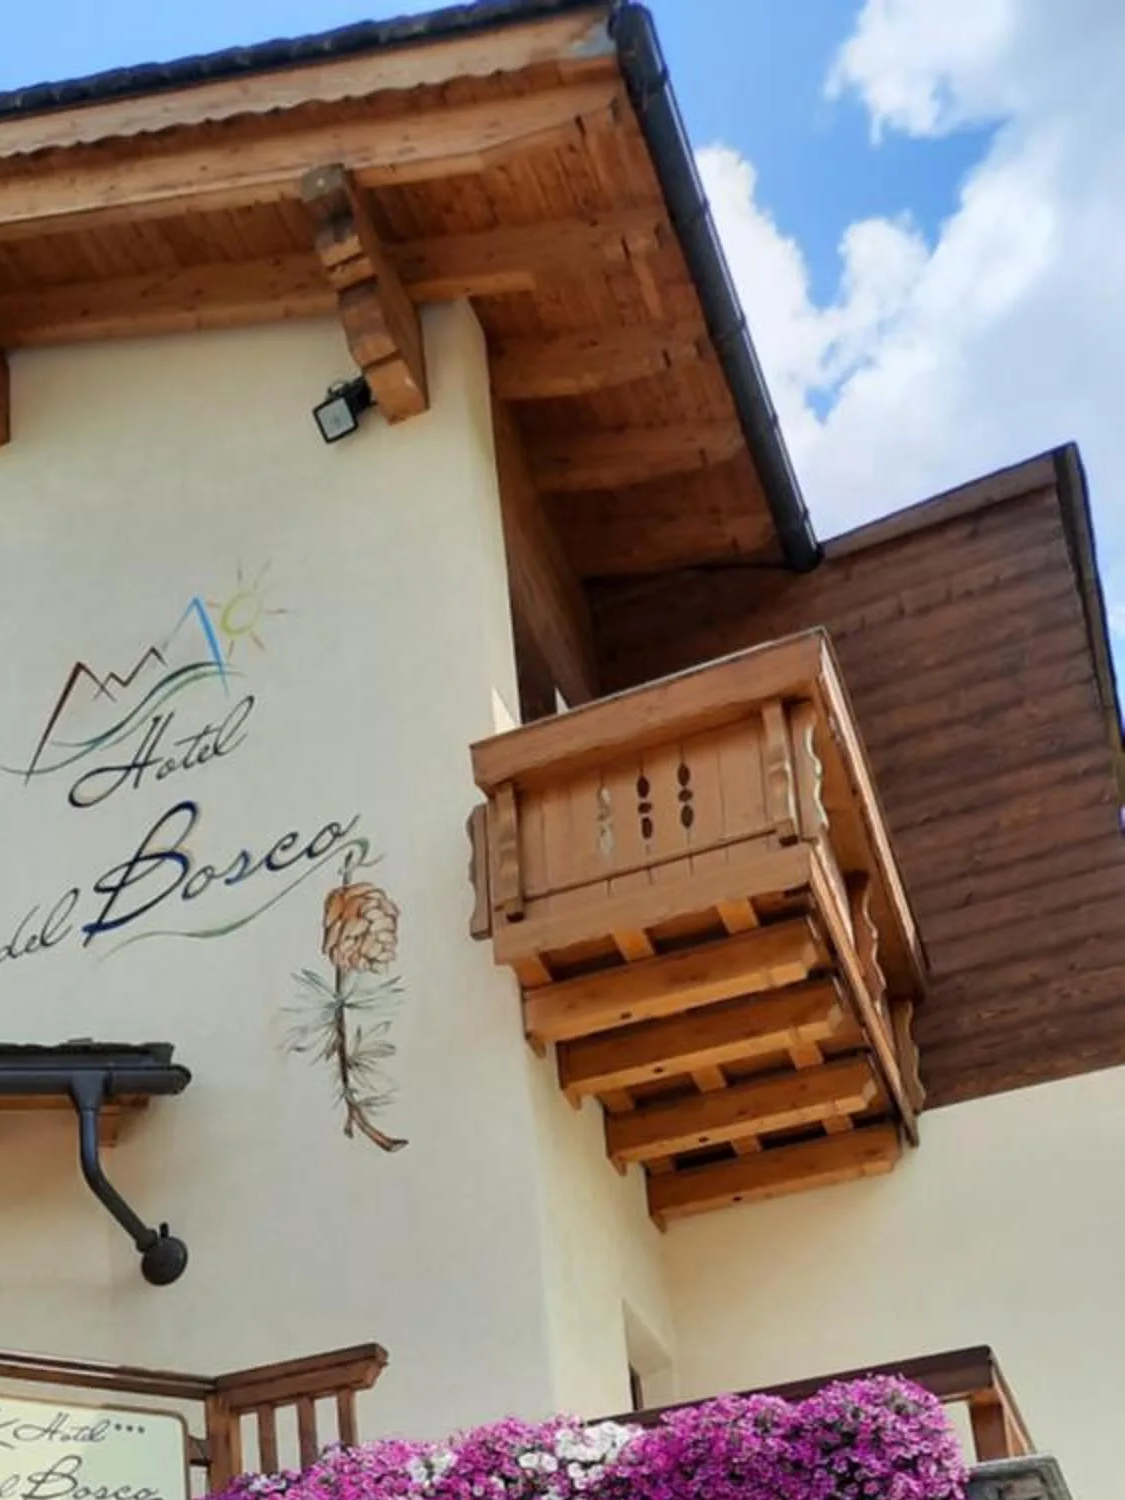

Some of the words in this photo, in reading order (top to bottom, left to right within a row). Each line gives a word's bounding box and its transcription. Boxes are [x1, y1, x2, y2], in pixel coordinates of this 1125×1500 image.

[68, 695, 255, 807] Hotel
[81, 801, 360, 946] Bosco
[13, 1412, 111, 1444] Hotel
